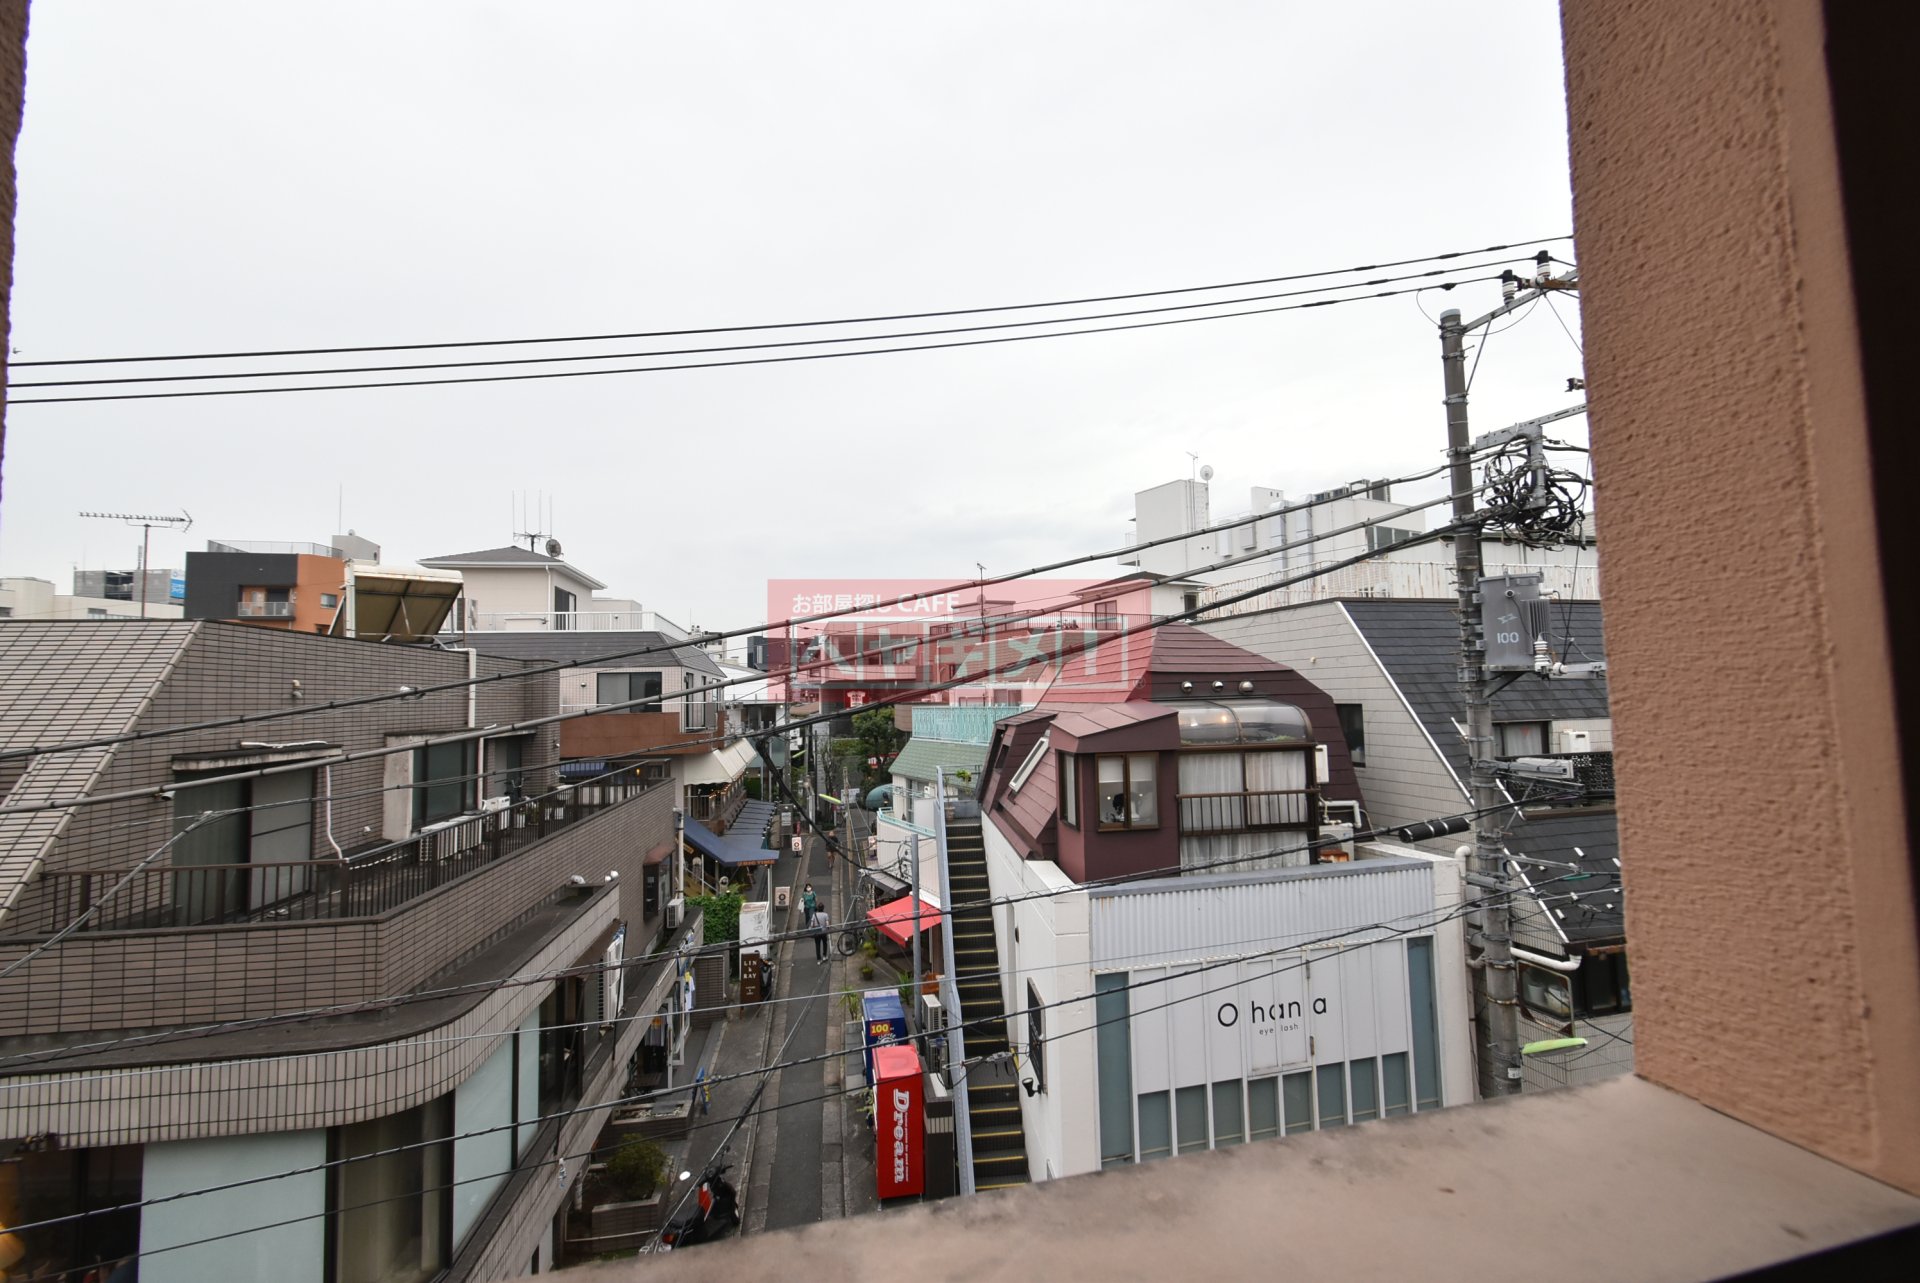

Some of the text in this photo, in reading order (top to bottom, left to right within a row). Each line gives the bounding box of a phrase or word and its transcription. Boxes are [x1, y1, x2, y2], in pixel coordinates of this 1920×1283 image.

[1497, 632, 1519, 644] 100
[871, 1024, 889, 1034] 100
[893, 1088, 910, 1184] Dream
